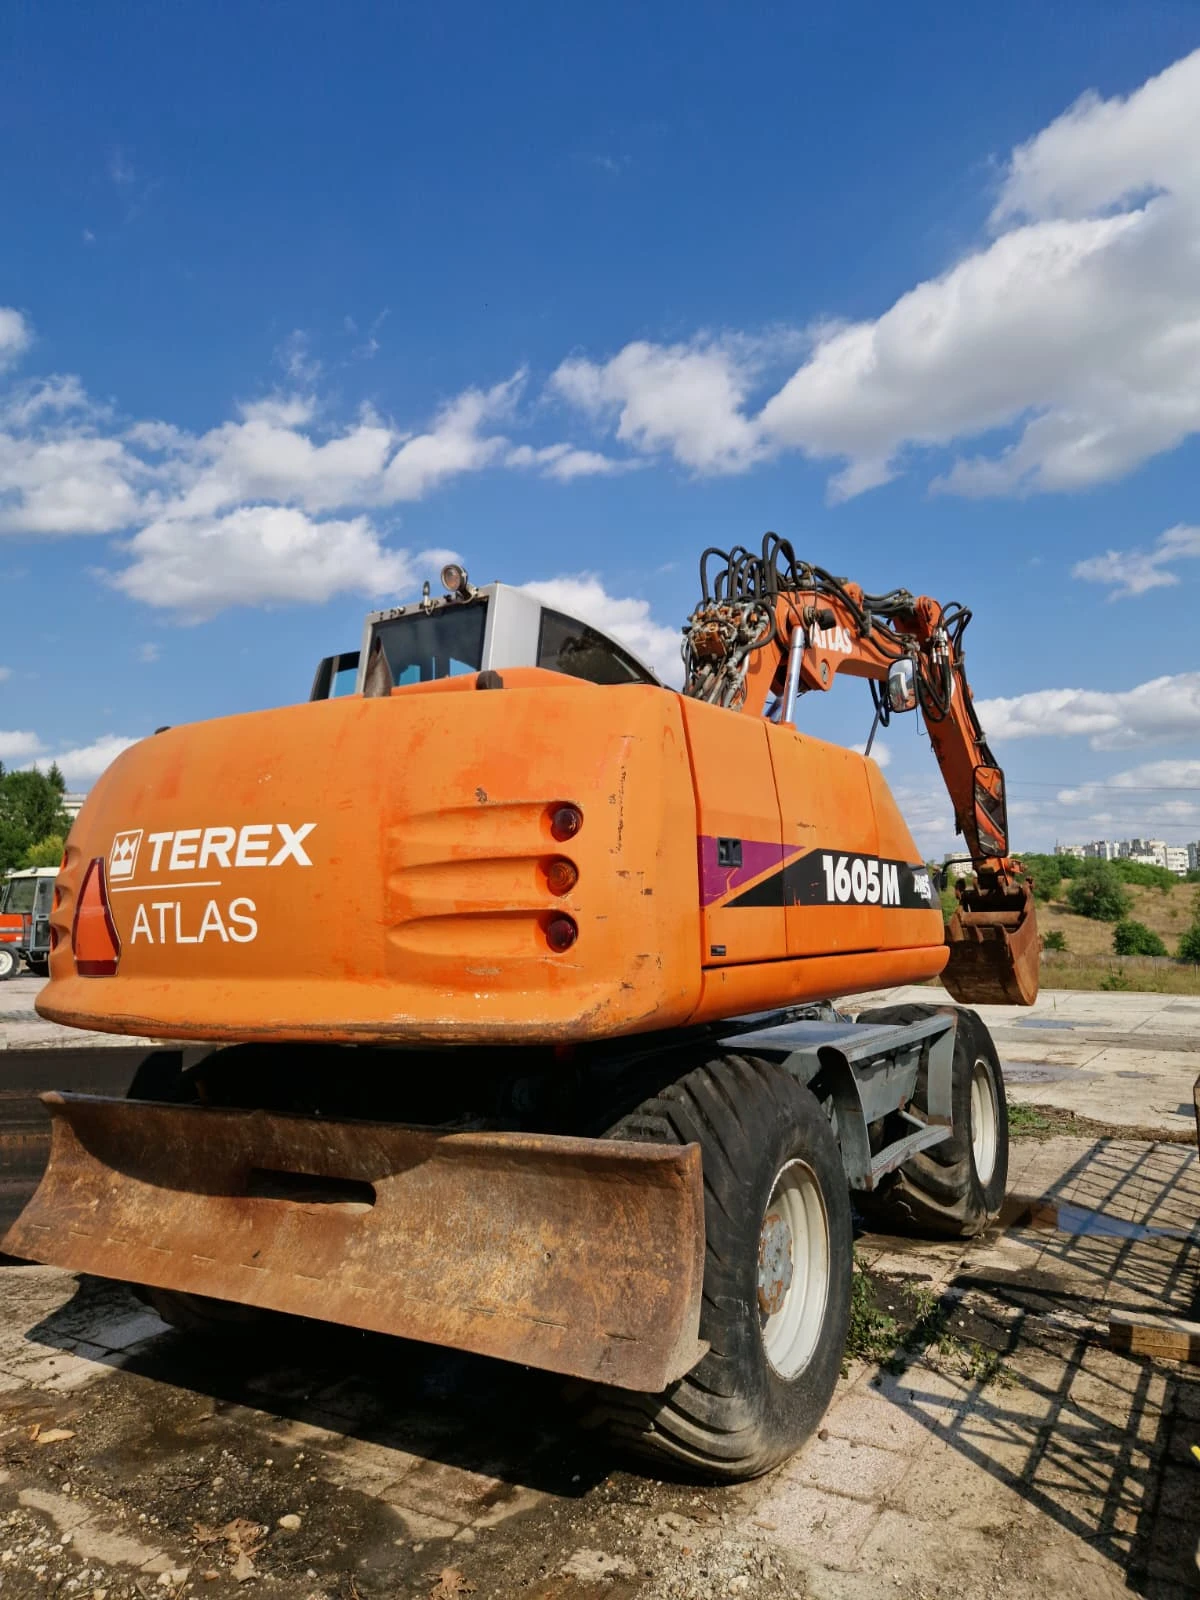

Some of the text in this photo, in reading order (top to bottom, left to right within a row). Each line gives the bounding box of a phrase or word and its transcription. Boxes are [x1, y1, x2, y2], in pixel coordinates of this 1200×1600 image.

[147, 823, 318, 872] TEREX
[822, 854, 901, 905] 1605M
[130, 897, 258, 944] ATLAS
